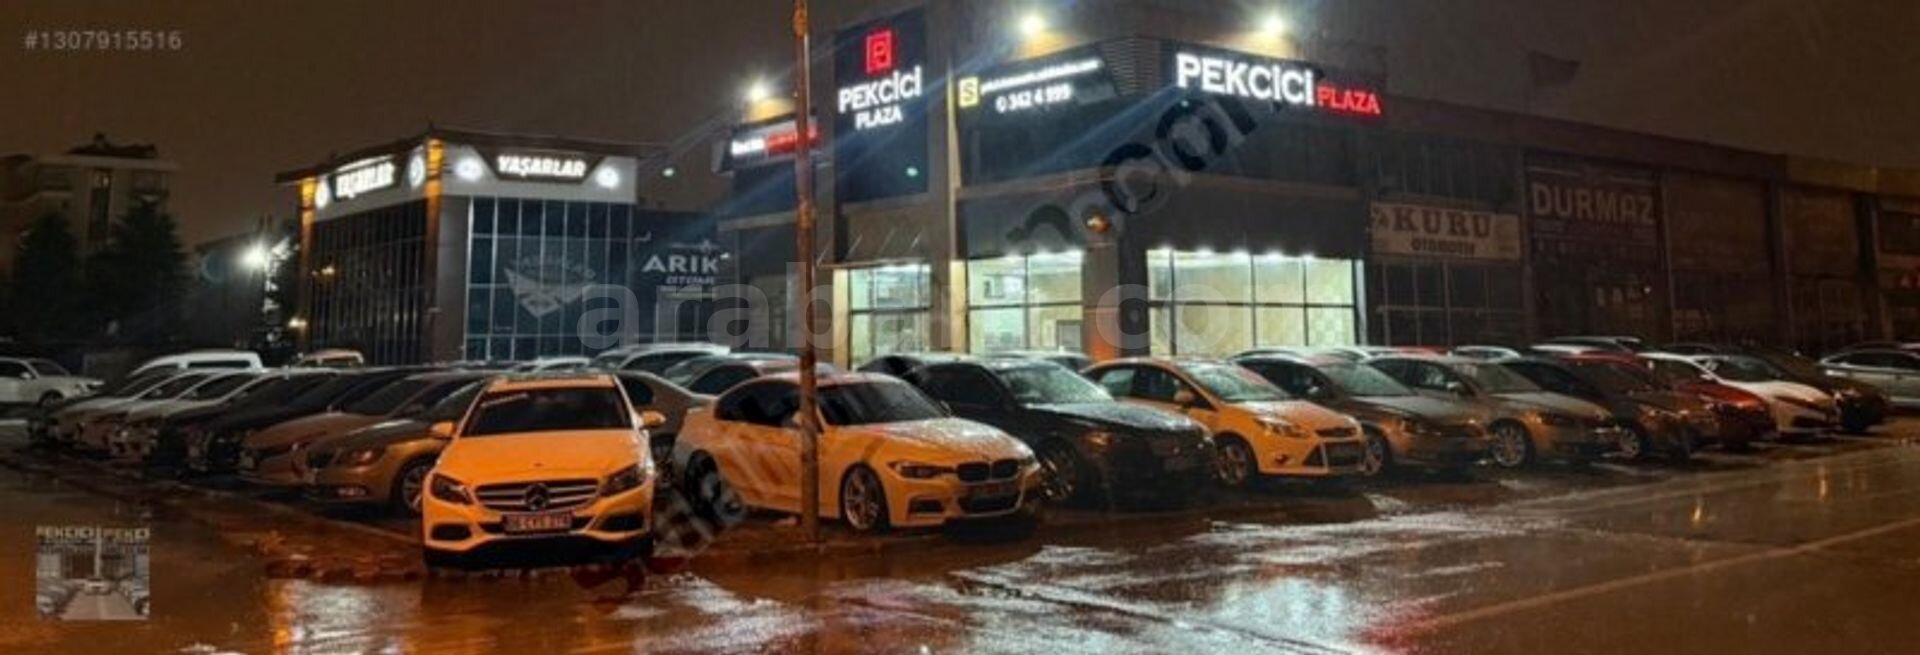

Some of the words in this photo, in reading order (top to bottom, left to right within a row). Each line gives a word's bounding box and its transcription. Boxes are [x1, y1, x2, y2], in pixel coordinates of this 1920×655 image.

[1317, 85, 1381, 115] PLAZA
[855, 105, 903, 130] PLAZA
[498, 155, 587, 178] YAŞARLAR
[1531, 182, 1656, 225] DURMAZ
[1392, 206, 1491, 239] KURU
[641, 253, 720, 274] ARIK
